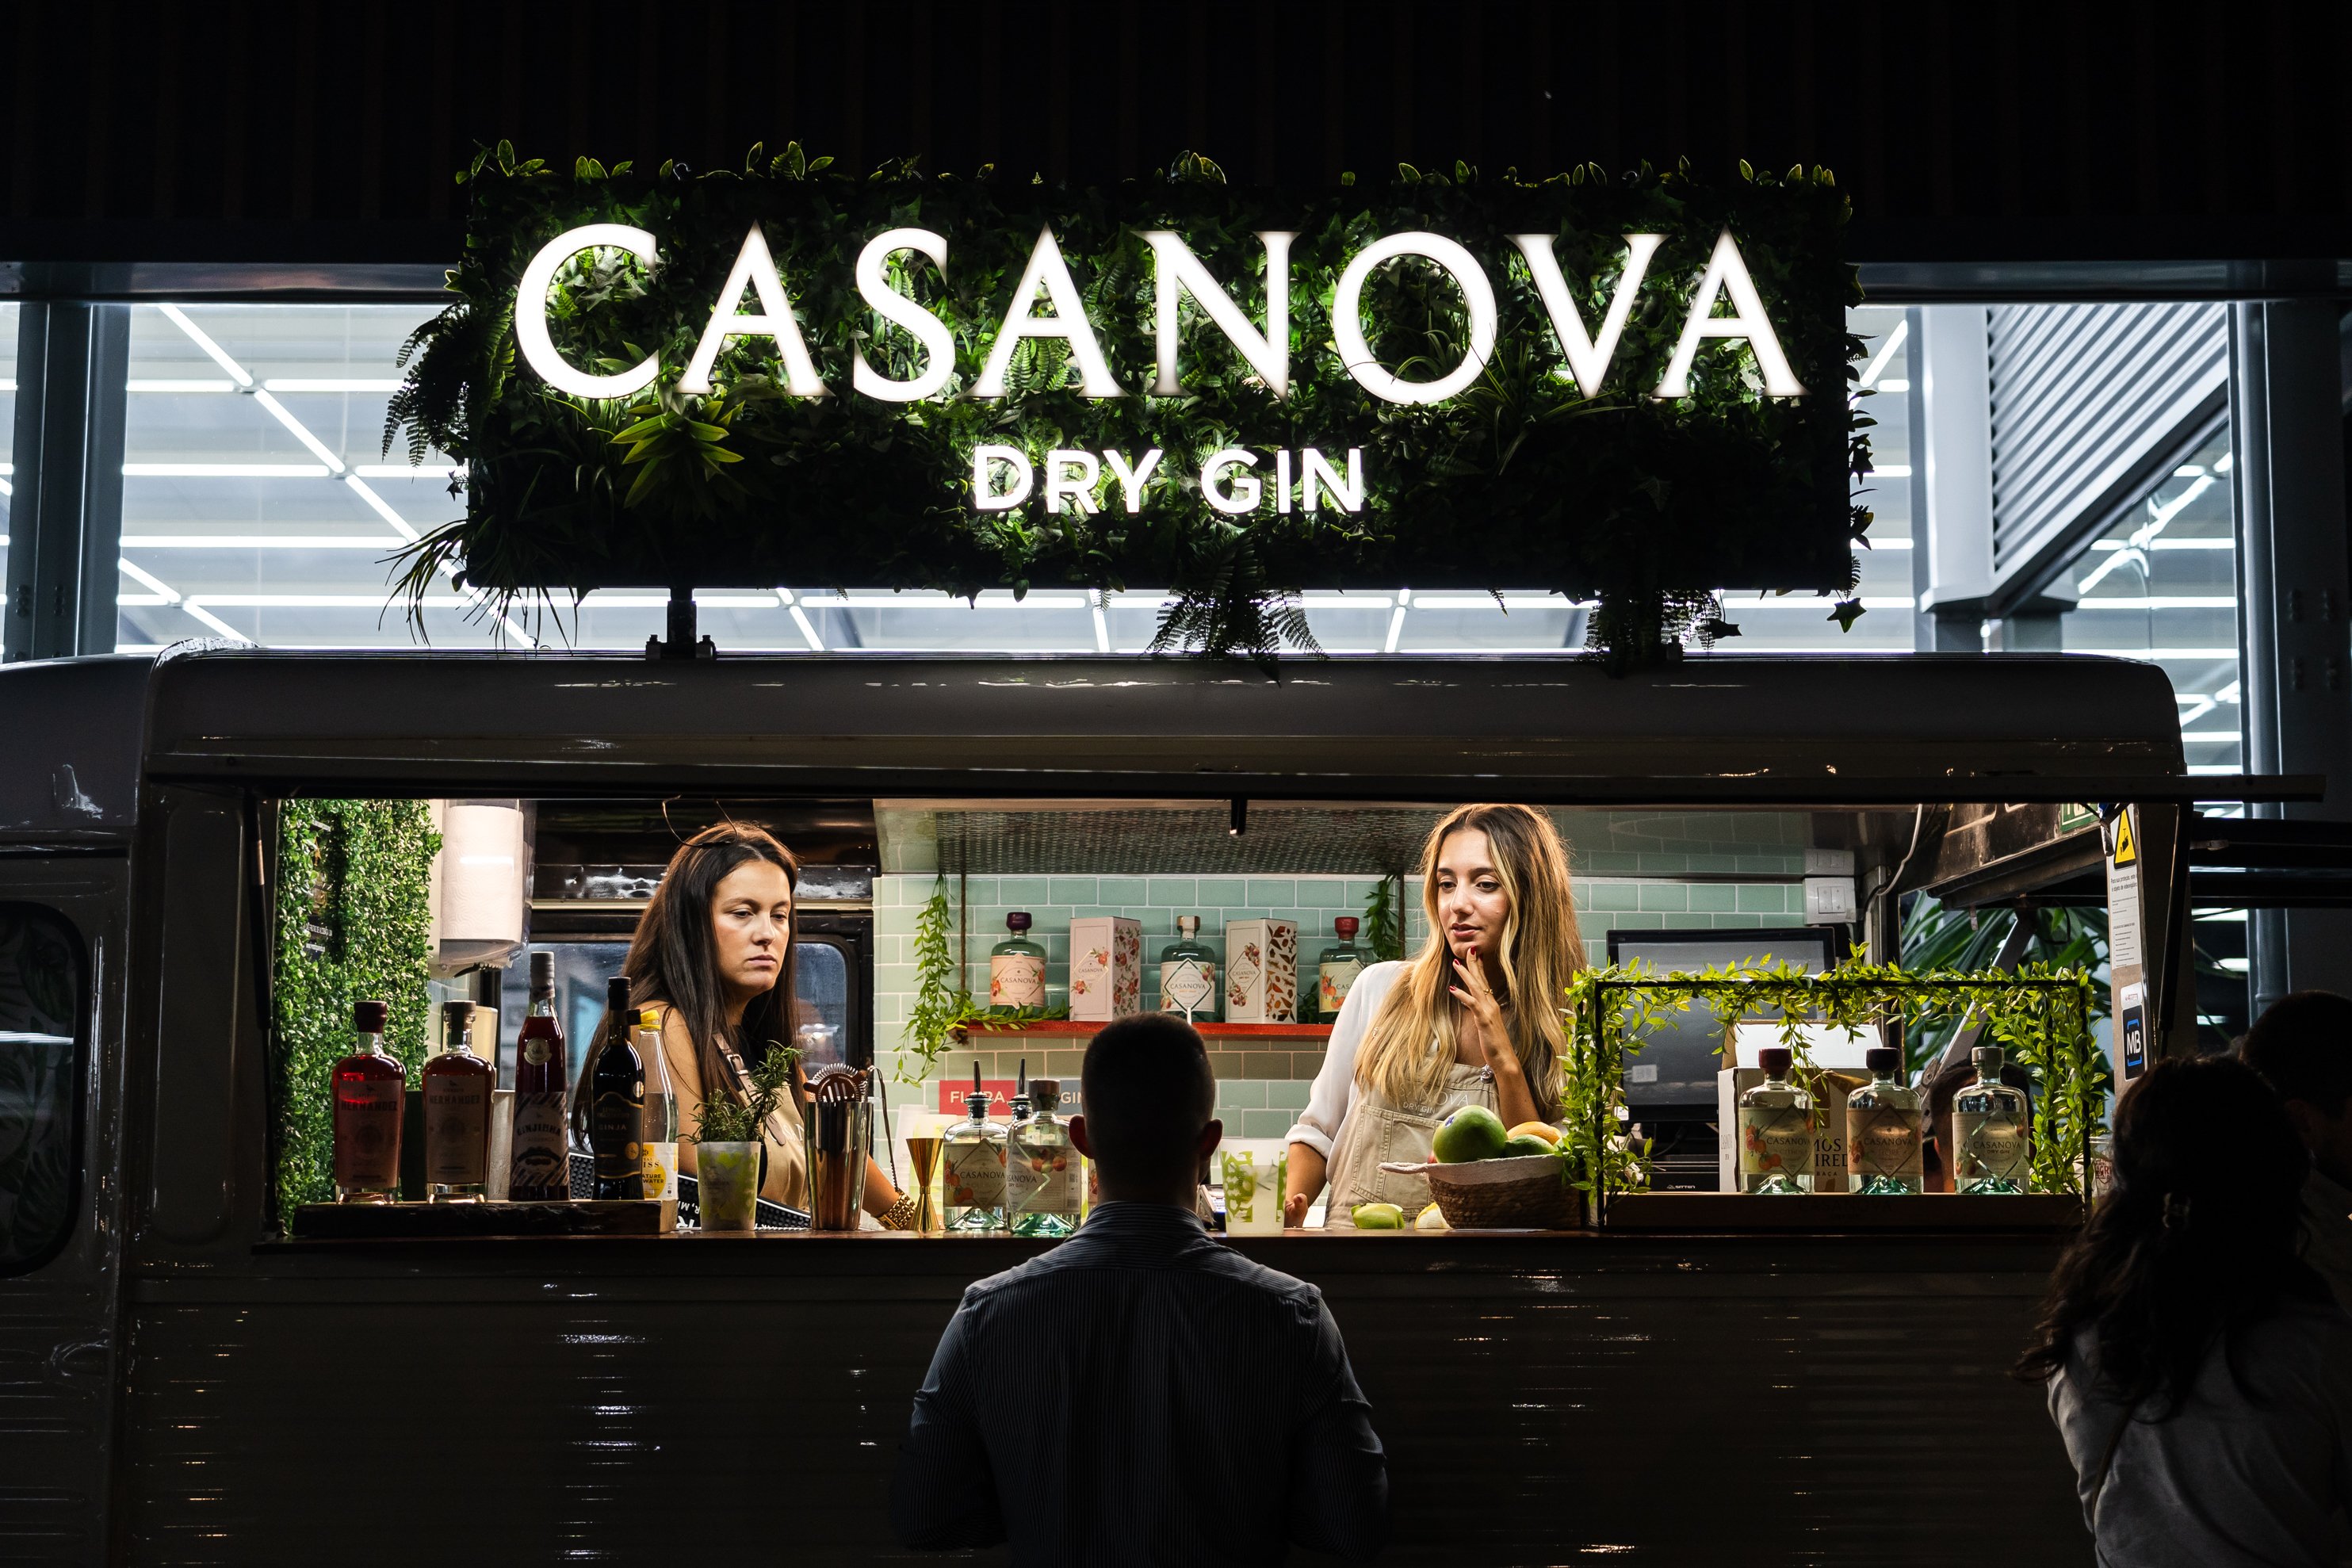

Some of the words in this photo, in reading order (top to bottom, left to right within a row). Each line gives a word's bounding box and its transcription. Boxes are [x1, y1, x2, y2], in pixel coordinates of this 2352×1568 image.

[515, 220, 1811, 405] CASANOVA
[973, 445, 1162, 514] DRY
[1200, 448, 1362, 515] GIN
[2126, 1029, 2142, 1056] MB
[341, 1100, 398, 1111] HERNANDEZ
[1402, 1101, 1420, 1111] DRY
[1420, 1105, 1436, 1115] GIN
[1766, 1136, 1811, 1146] CASANOVA
[1863, 1137, 1913, 1146] CASANOVA
[1973, 1141, 2021, 1149] CASANOVA
[959, 1170, 1006, 1180] CASANOVA
